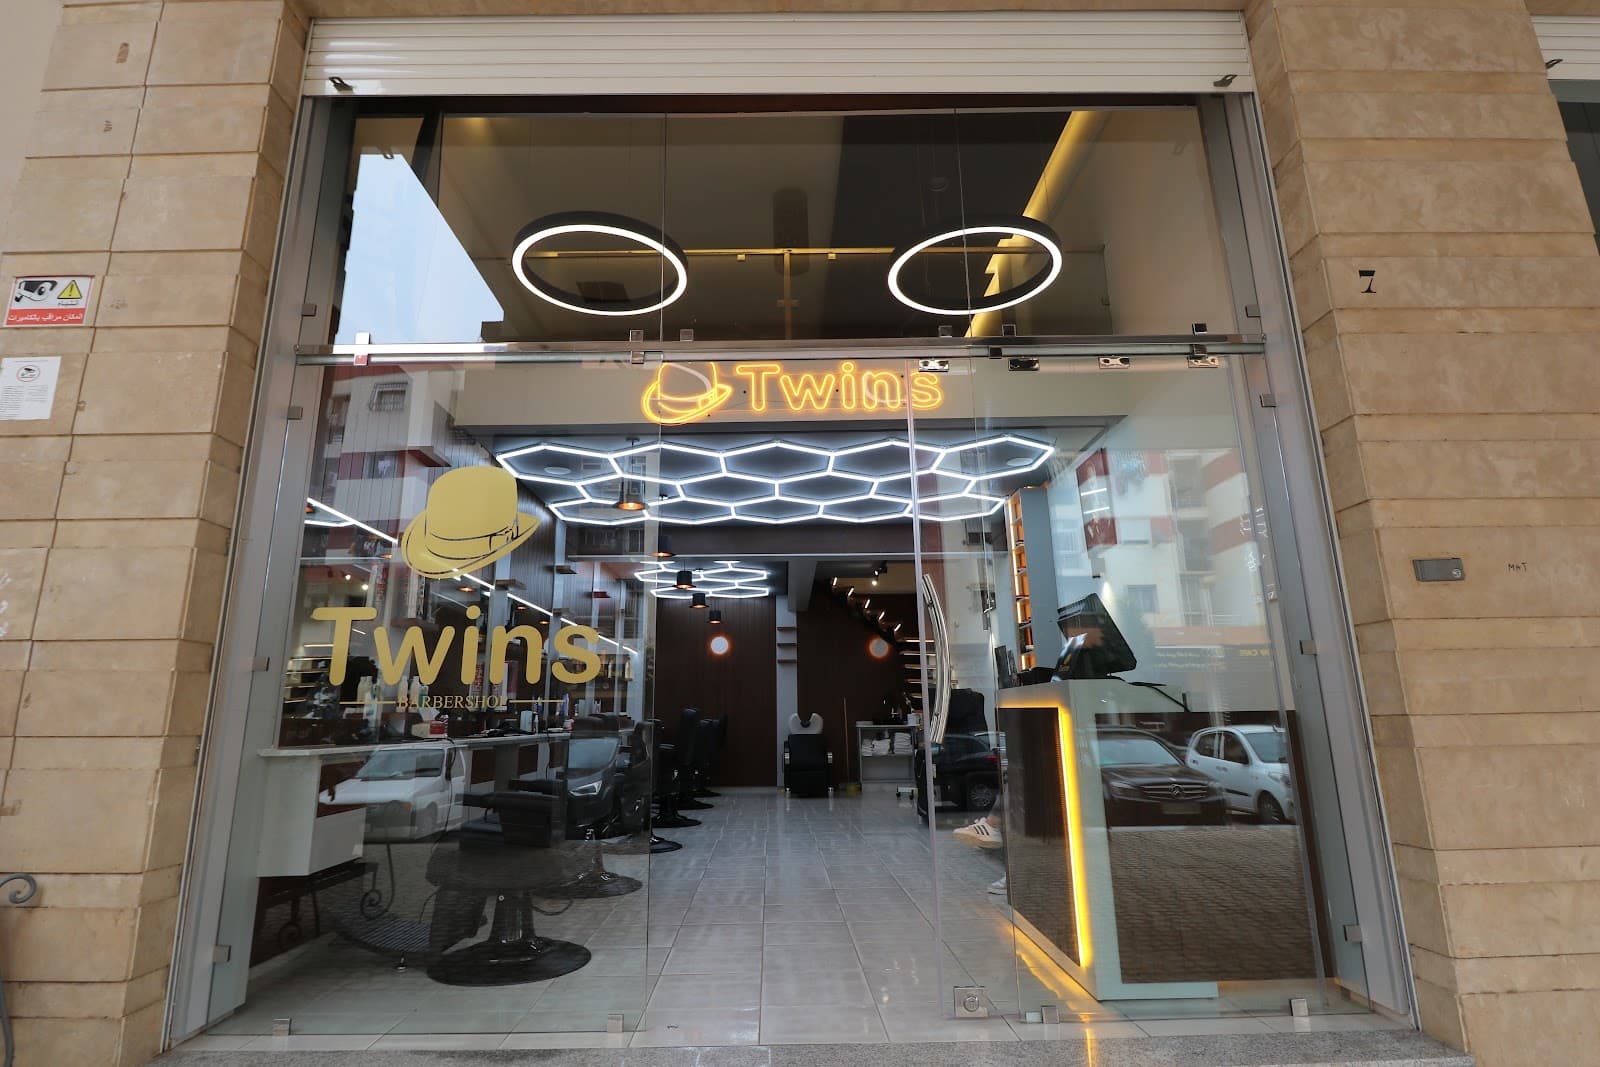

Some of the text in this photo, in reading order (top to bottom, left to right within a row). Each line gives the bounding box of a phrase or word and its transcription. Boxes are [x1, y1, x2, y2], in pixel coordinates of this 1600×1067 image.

[1358, 269, 1377, 294] 7
[735, 361, 943, 412] Twins
[310, 605, 601, 686] Twins
